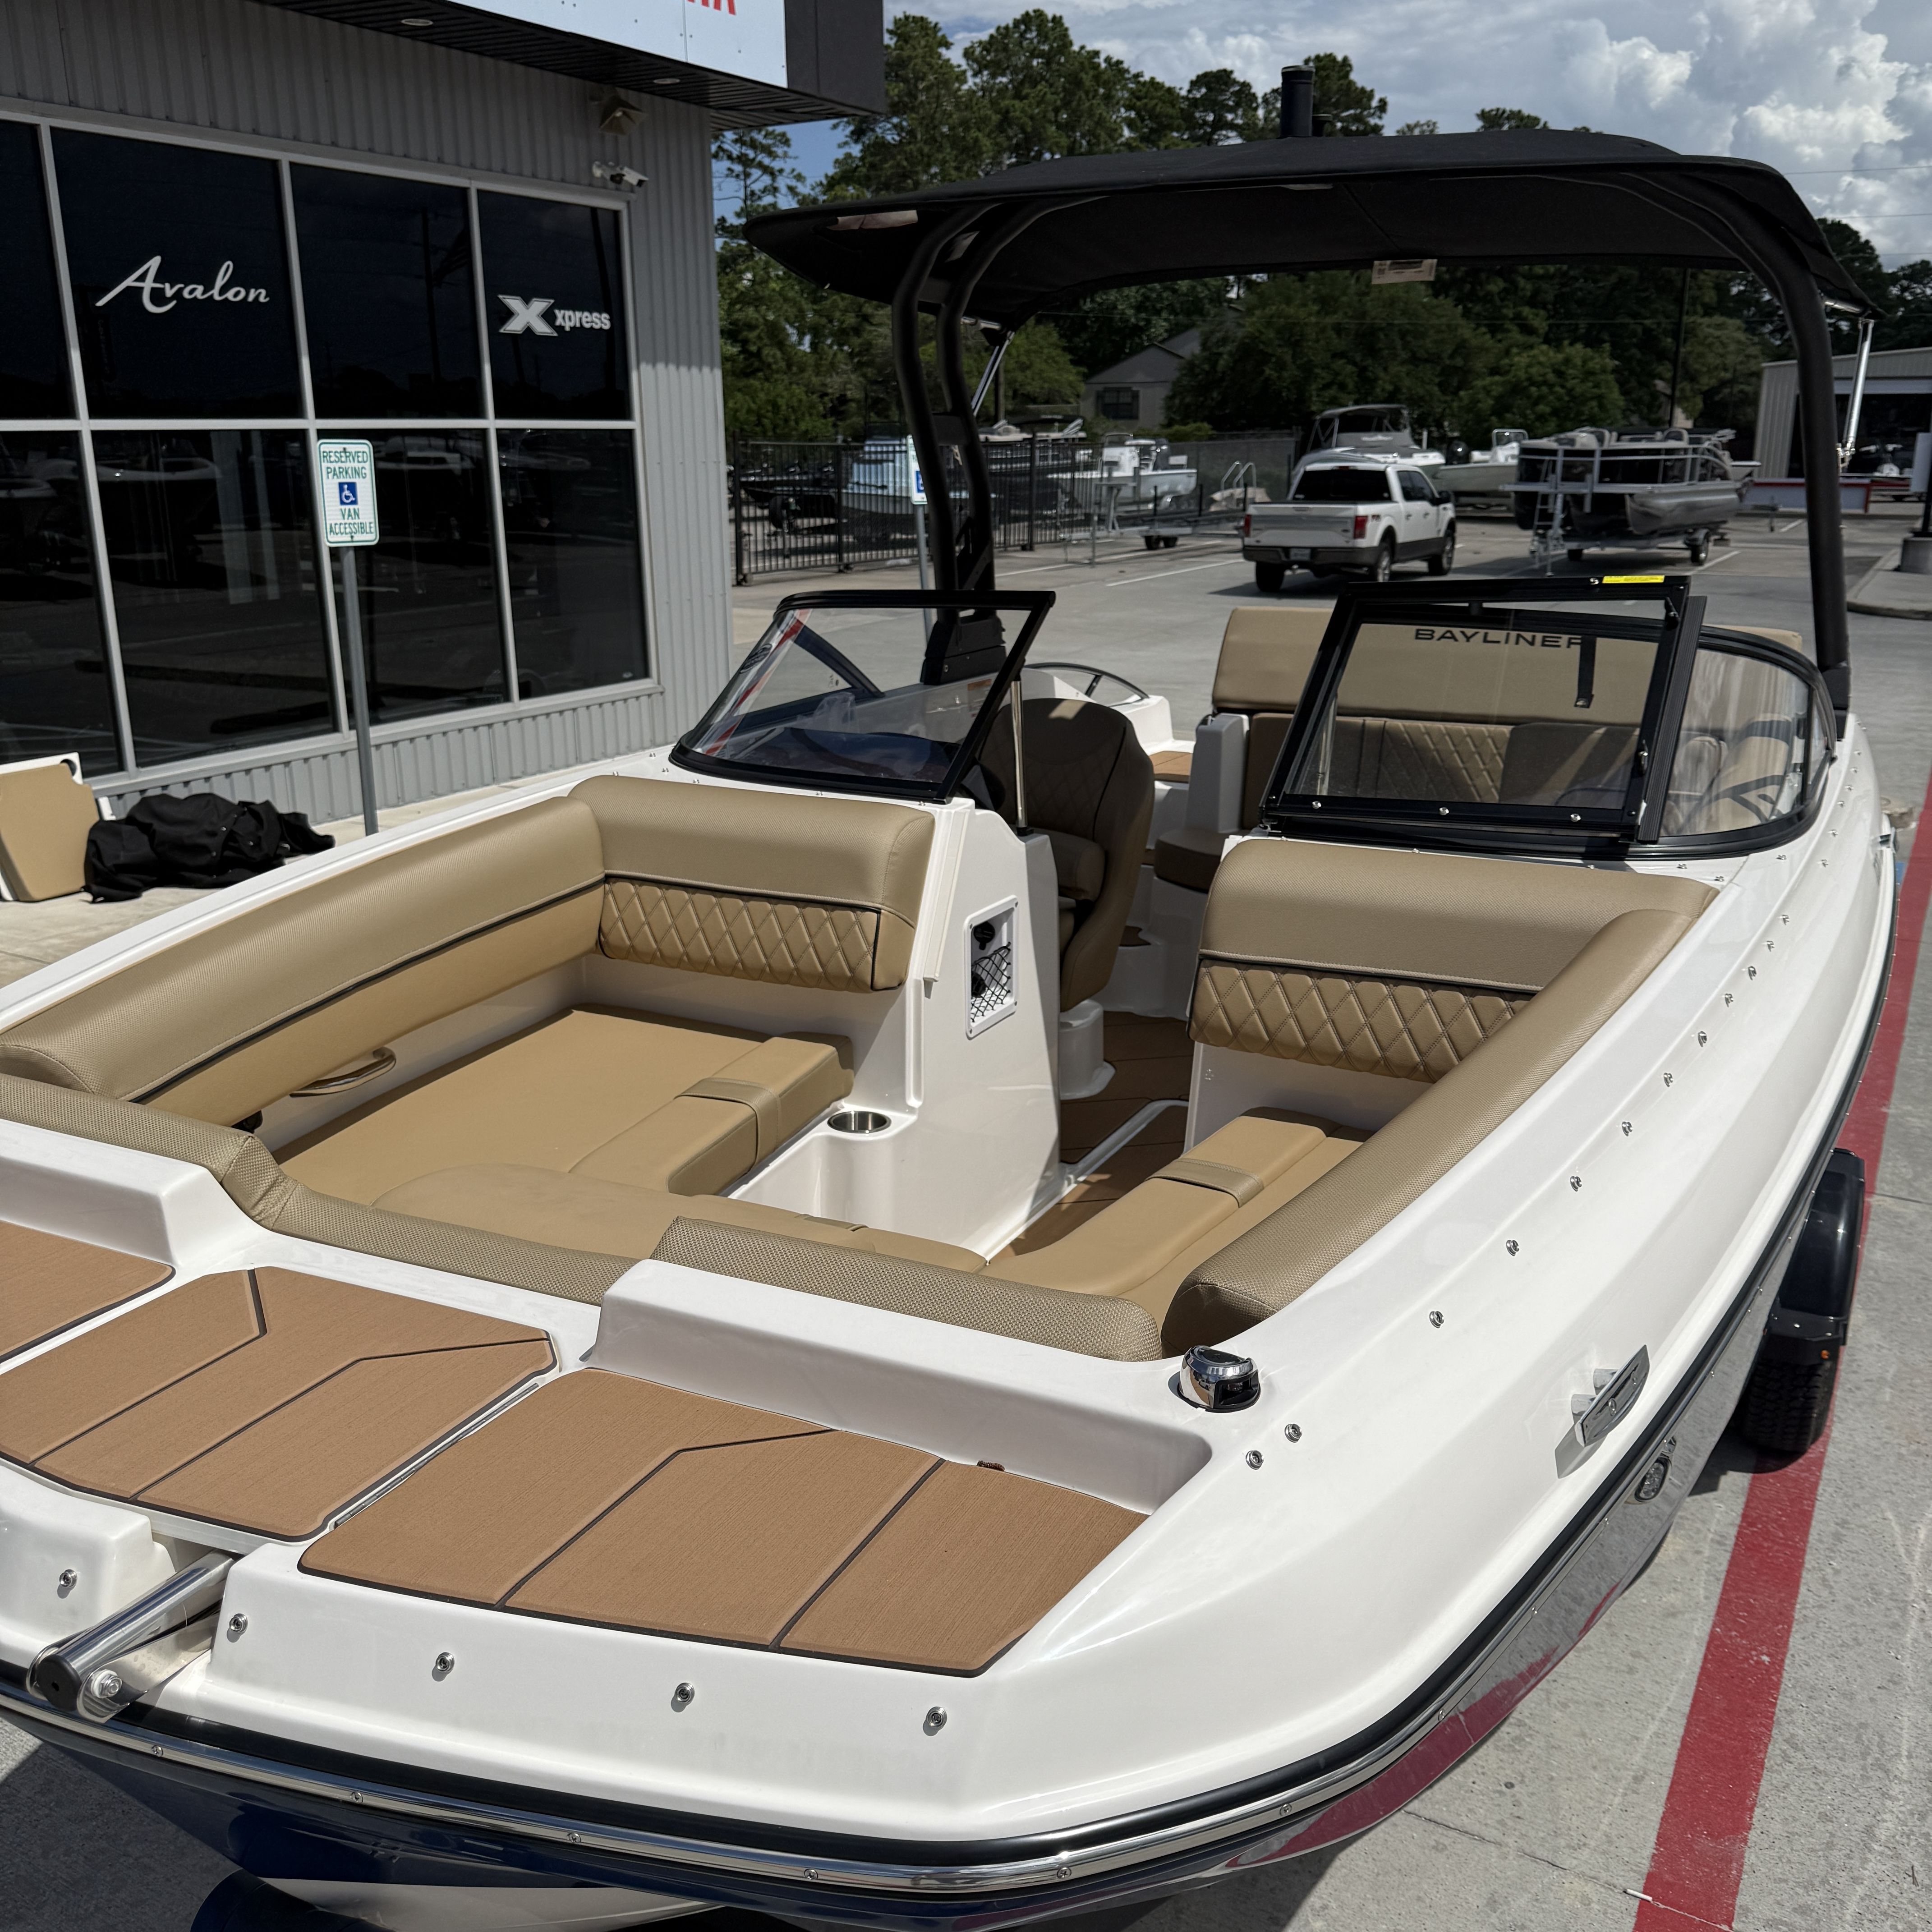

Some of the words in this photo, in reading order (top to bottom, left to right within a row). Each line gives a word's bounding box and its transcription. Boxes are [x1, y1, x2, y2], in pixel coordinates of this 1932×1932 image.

[95, 255, 270, 313] Avalon
[554, 309, 611, 331] xpress
[322, 451, 368, 464] RESERVED
[326, 466, 367, 479] PARKING
[340, 507, 360, 520] VAN
[329, 522, 374, 536] ACCESSIBLE
